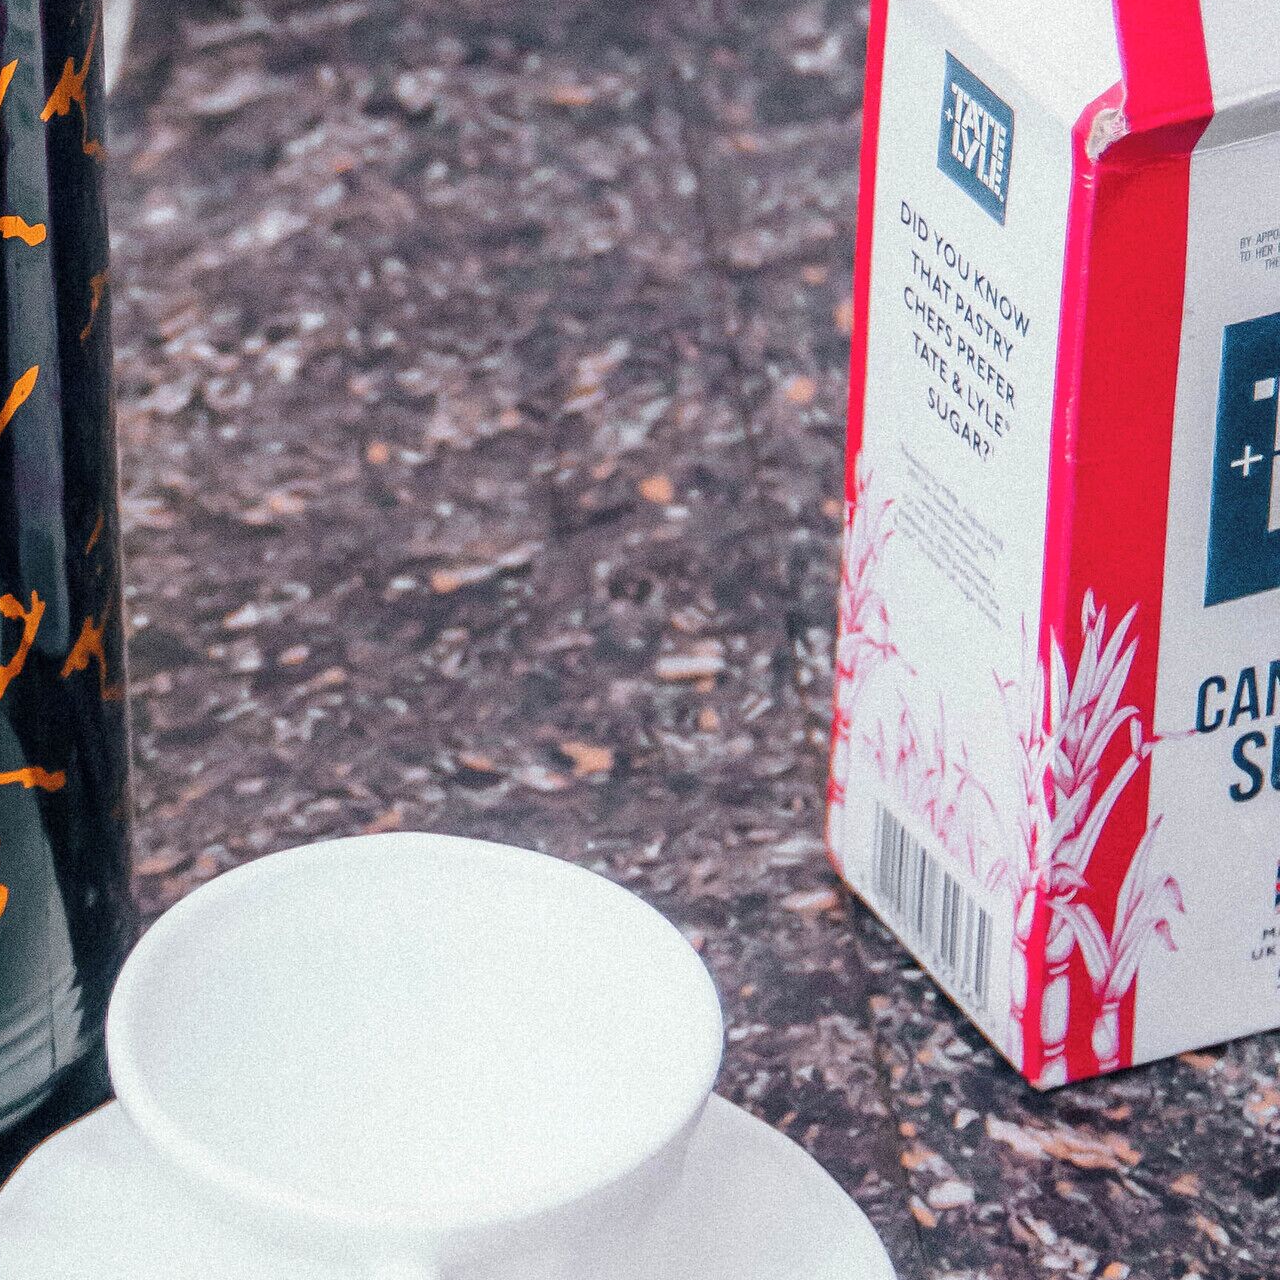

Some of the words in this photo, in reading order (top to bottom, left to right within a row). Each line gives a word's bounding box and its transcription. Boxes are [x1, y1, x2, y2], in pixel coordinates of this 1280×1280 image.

[901, 200, 928, 241] DID
[934, 230, 970, 280] YOU
[974, 269, 1030, 337] KNOW
[912, 249, 951, 304] THAT
[956, 293, 1013, 362] PASTRY
[1240, 250, 1251, 262] TO
[1256, 244, 1273, 258] HER
[904, 286, 952, 347] CHEFS
[958, 335, 1015, 410] PREFER
[913, 331, 947, 383] TATE
[952, 372, 962, 398] &
